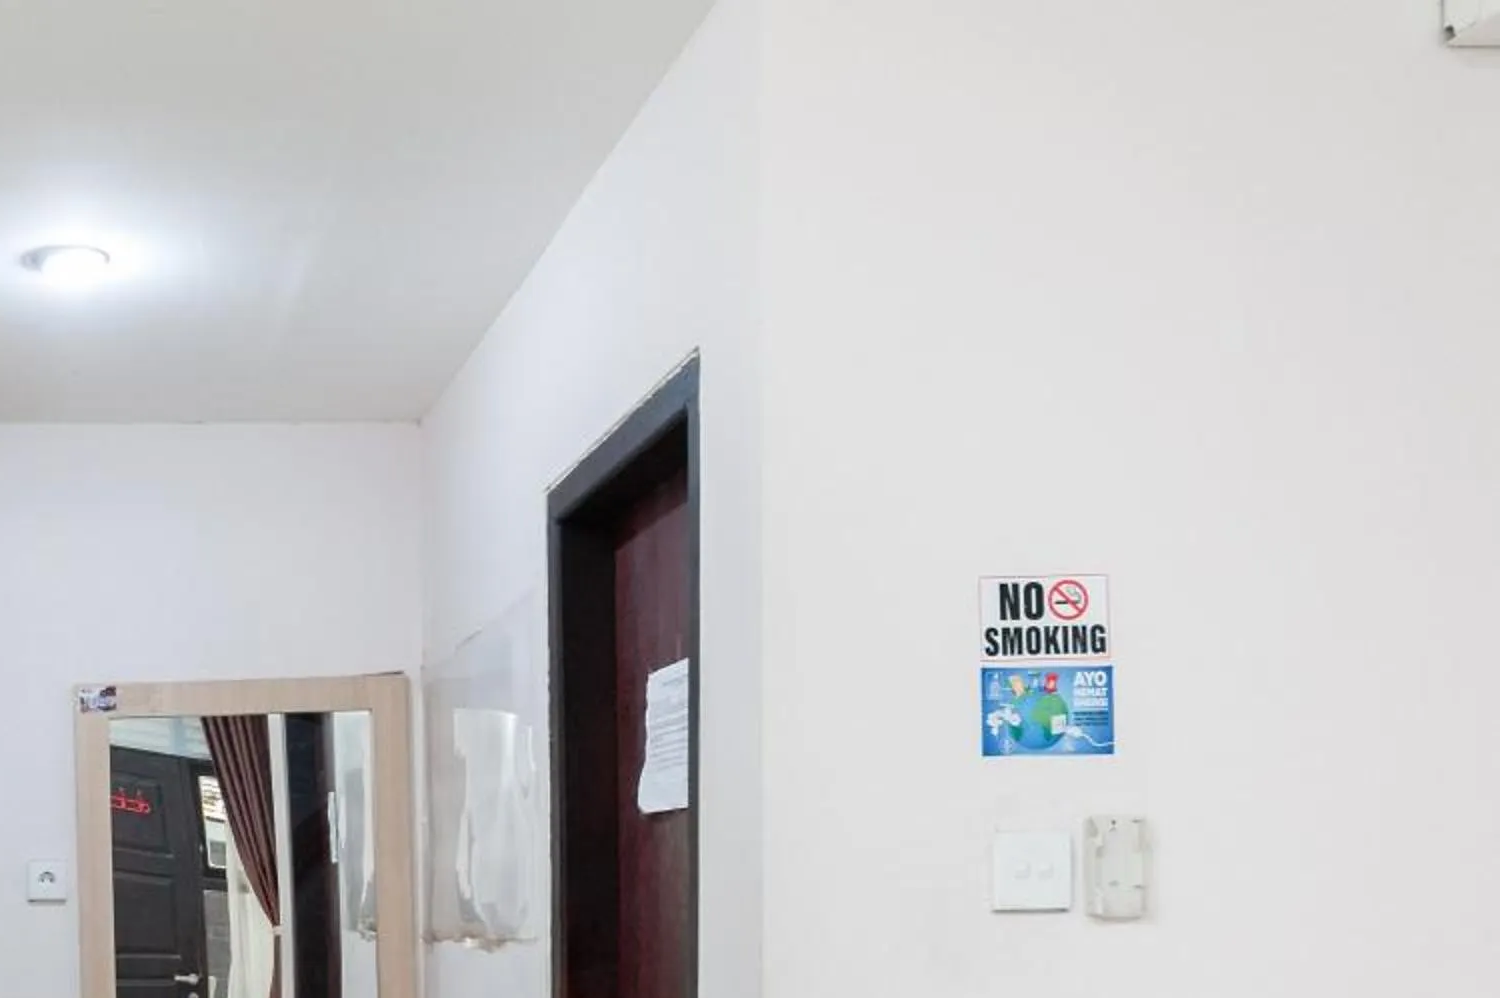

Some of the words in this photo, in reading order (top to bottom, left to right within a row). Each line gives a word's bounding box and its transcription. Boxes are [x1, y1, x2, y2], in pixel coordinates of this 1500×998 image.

[999, 582, 1045, 621] NO
[985, 624, 1107, 656] SMOKING
[1074, 671, 1107, 687] AYO
